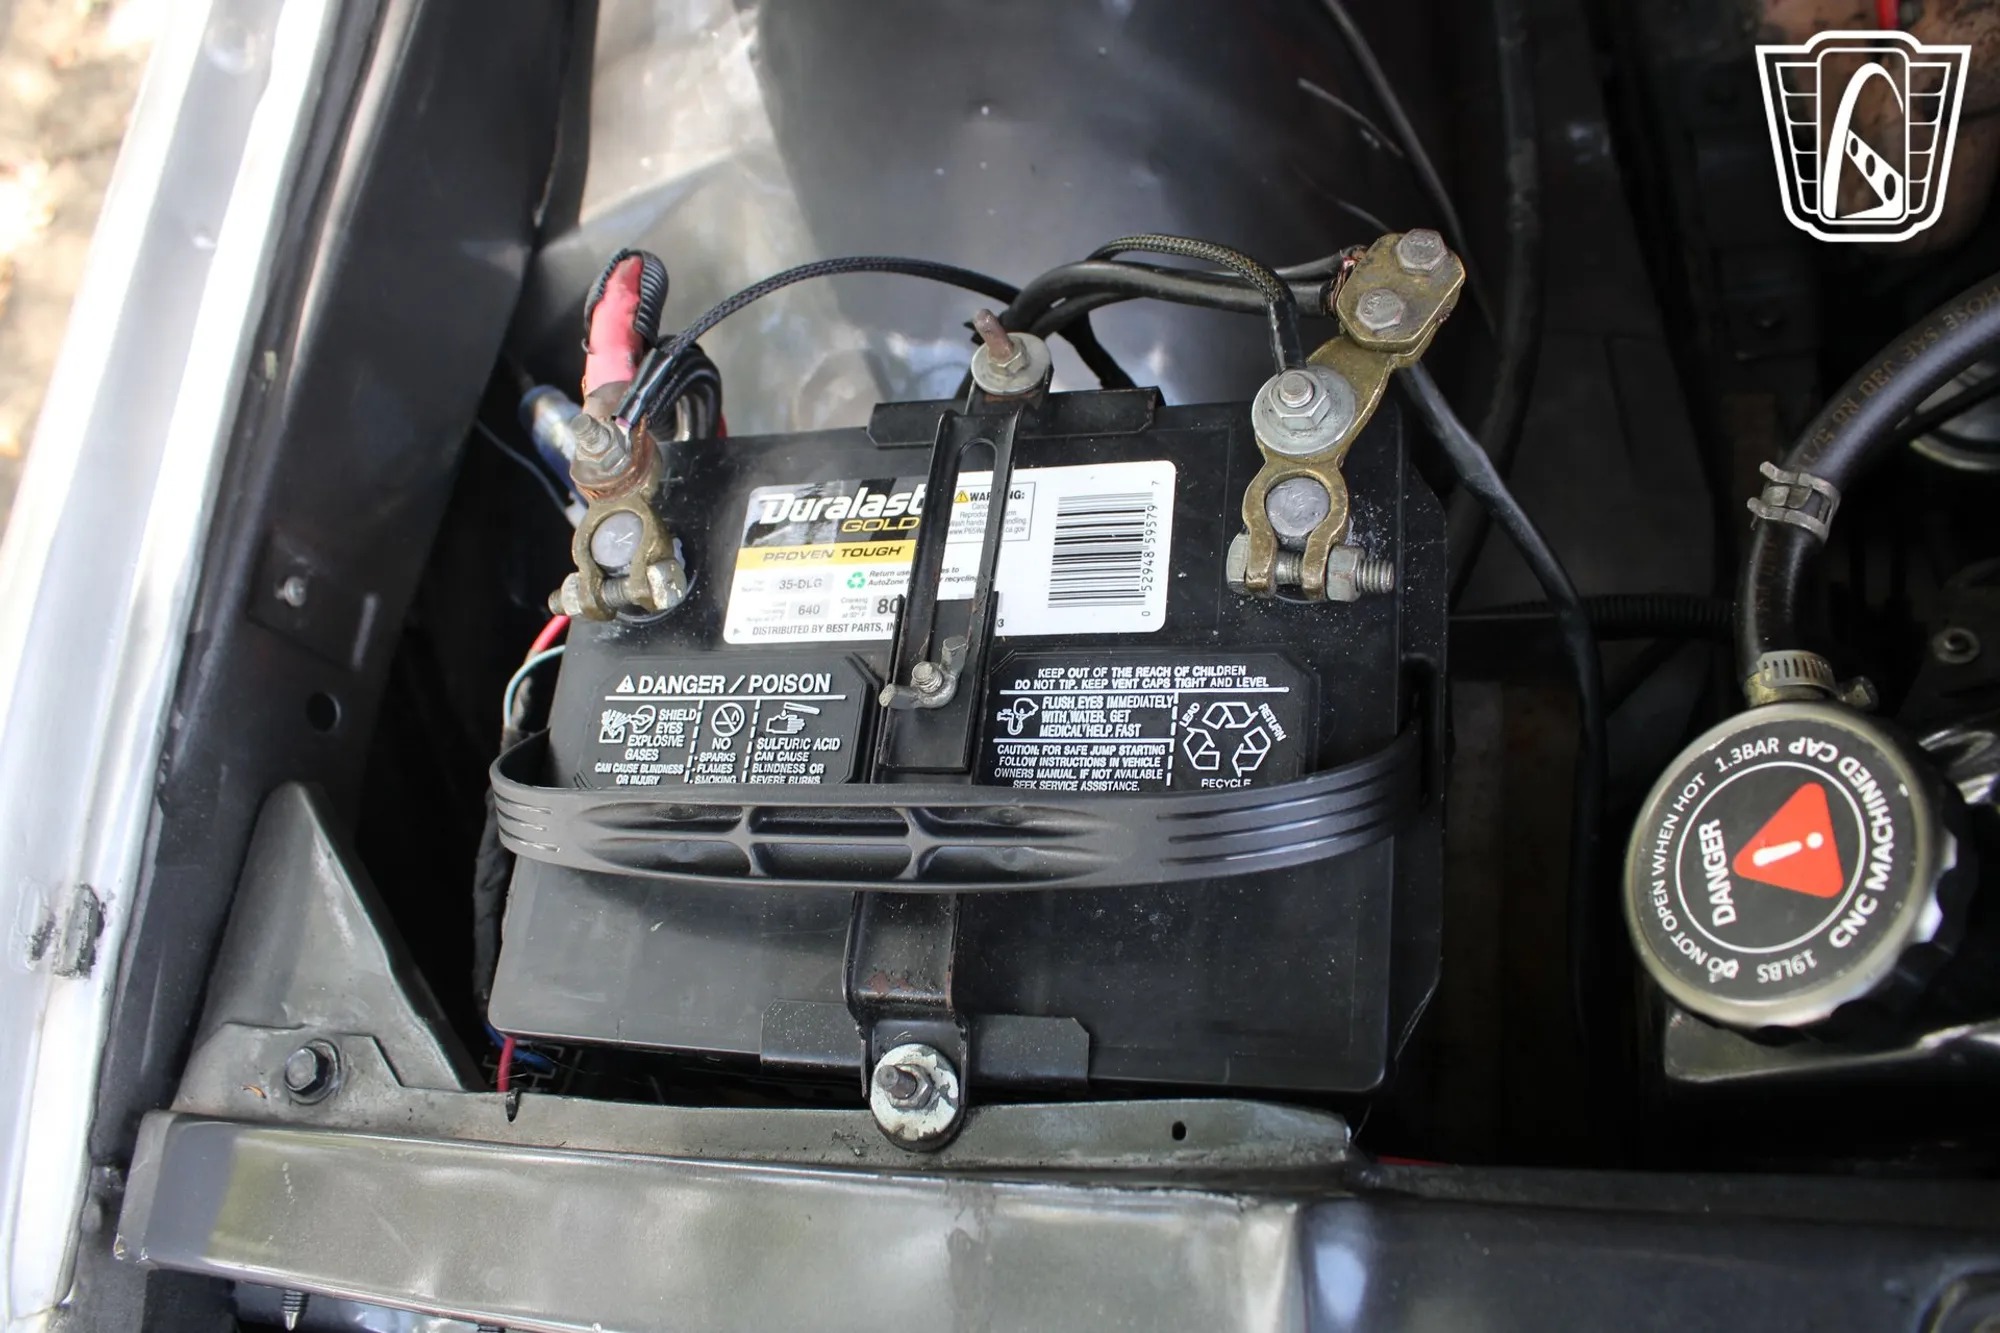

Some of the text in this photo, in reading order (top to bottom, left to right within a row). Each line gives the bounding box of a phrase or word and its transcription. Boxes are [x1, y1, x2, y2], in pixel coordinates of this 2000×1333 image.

[754, 483, 927, 525] Duralast
[841, 517, 921, 532] GOLD
[1145, 504, 1158, 544] 59579
[763, 549, 835, 562] PROVEN
[1141, 551, 1155, 592] 52948
[779, 578, 822, 590] 35-DLG
[868, 578, 904, 586] AutoZone
[798, 603, 820, 616] 640
[752, 625, 809, 636] DISTRIBUTED
[811, 624, 824, 633] BY
[826, 623, 850, 633] BEST
[851, 622, 884, 634] PARTS,
[1038, 665, 1246, 679] KEEP OUT OF THE REACH OF CHILDREN
[638, 675, 726, 694] DANGER
[747, 673, 832, 693] POISON
[1014, 677, 1270, 690] DO NOT TIP. KEEP VENT CAPS TIGHT AND LEVEL
[1042, 695, 1174, 709] FLUSH EYES IMMEDIATELY
[659, 708, 697, 721] SHIELD
[1041, 710, 1067, 723] WITH
[1109, 709, 1132, 723] GET
[1179, 702, 1201, 728] LEAD
[655, 722, 684, 734] EYES
[1258, 702, 1287, 742] RETURN
[1039, 723, 1083, 737] MEDICAL
[1115, 723, 1142, 737] FAST
[627, 735, 686, 747] EXPLOSIVE
[711, 737, 732, 750] NO
[756, 737, 841, 751] SULFURIC ACID
[625, 748, 660, 761] GASES
[754, 751, 810, 762] CAN CAUSE
[997, 744, 1166, 756] CAUTION: FOR SAFE JUMP STARTING
[1714, 737, 1780, 774] 1.3BAR
[699, 752, 736, 763] SPARKS
[999, 756, 1161, 768] FOLLOW INSTRUCTIONS IN VEHICLE
[595, 762, 685, 774] CAN CAUSE BLINDNESS
[696, 763, 734, 774] FLAMES
[752, 763, 825, 774] BLINDNESS OR
[994, 768, 1034, 779] OWNERS
[1079, 768, 1090, 779] IF
[1091, 768, 1113, 780] NOT
[1114, 768, 1164, 780] AVAILABLE
[616, 774, 661, 785] OR INJURY
[694, 775, 737, 784] SMOKING
[1012, 780, 1140, 792] SEEK SERVICE ASSISTANCE.
[1201, 778, 1252, 788] RECYCLE
[1673, 772, 1707, 812] HOT
[1652, 813, 1680, 877] WHEN
[1788, 737, 1895, 949] CNC MACHINED CAP
[1698, 819, 1737, 927] DANGER
[1652, 879, 1678, 932] OPEN
[1670, 931, 1709, 966] NOT
[1757, 949, 1818, 984] 19LBS
